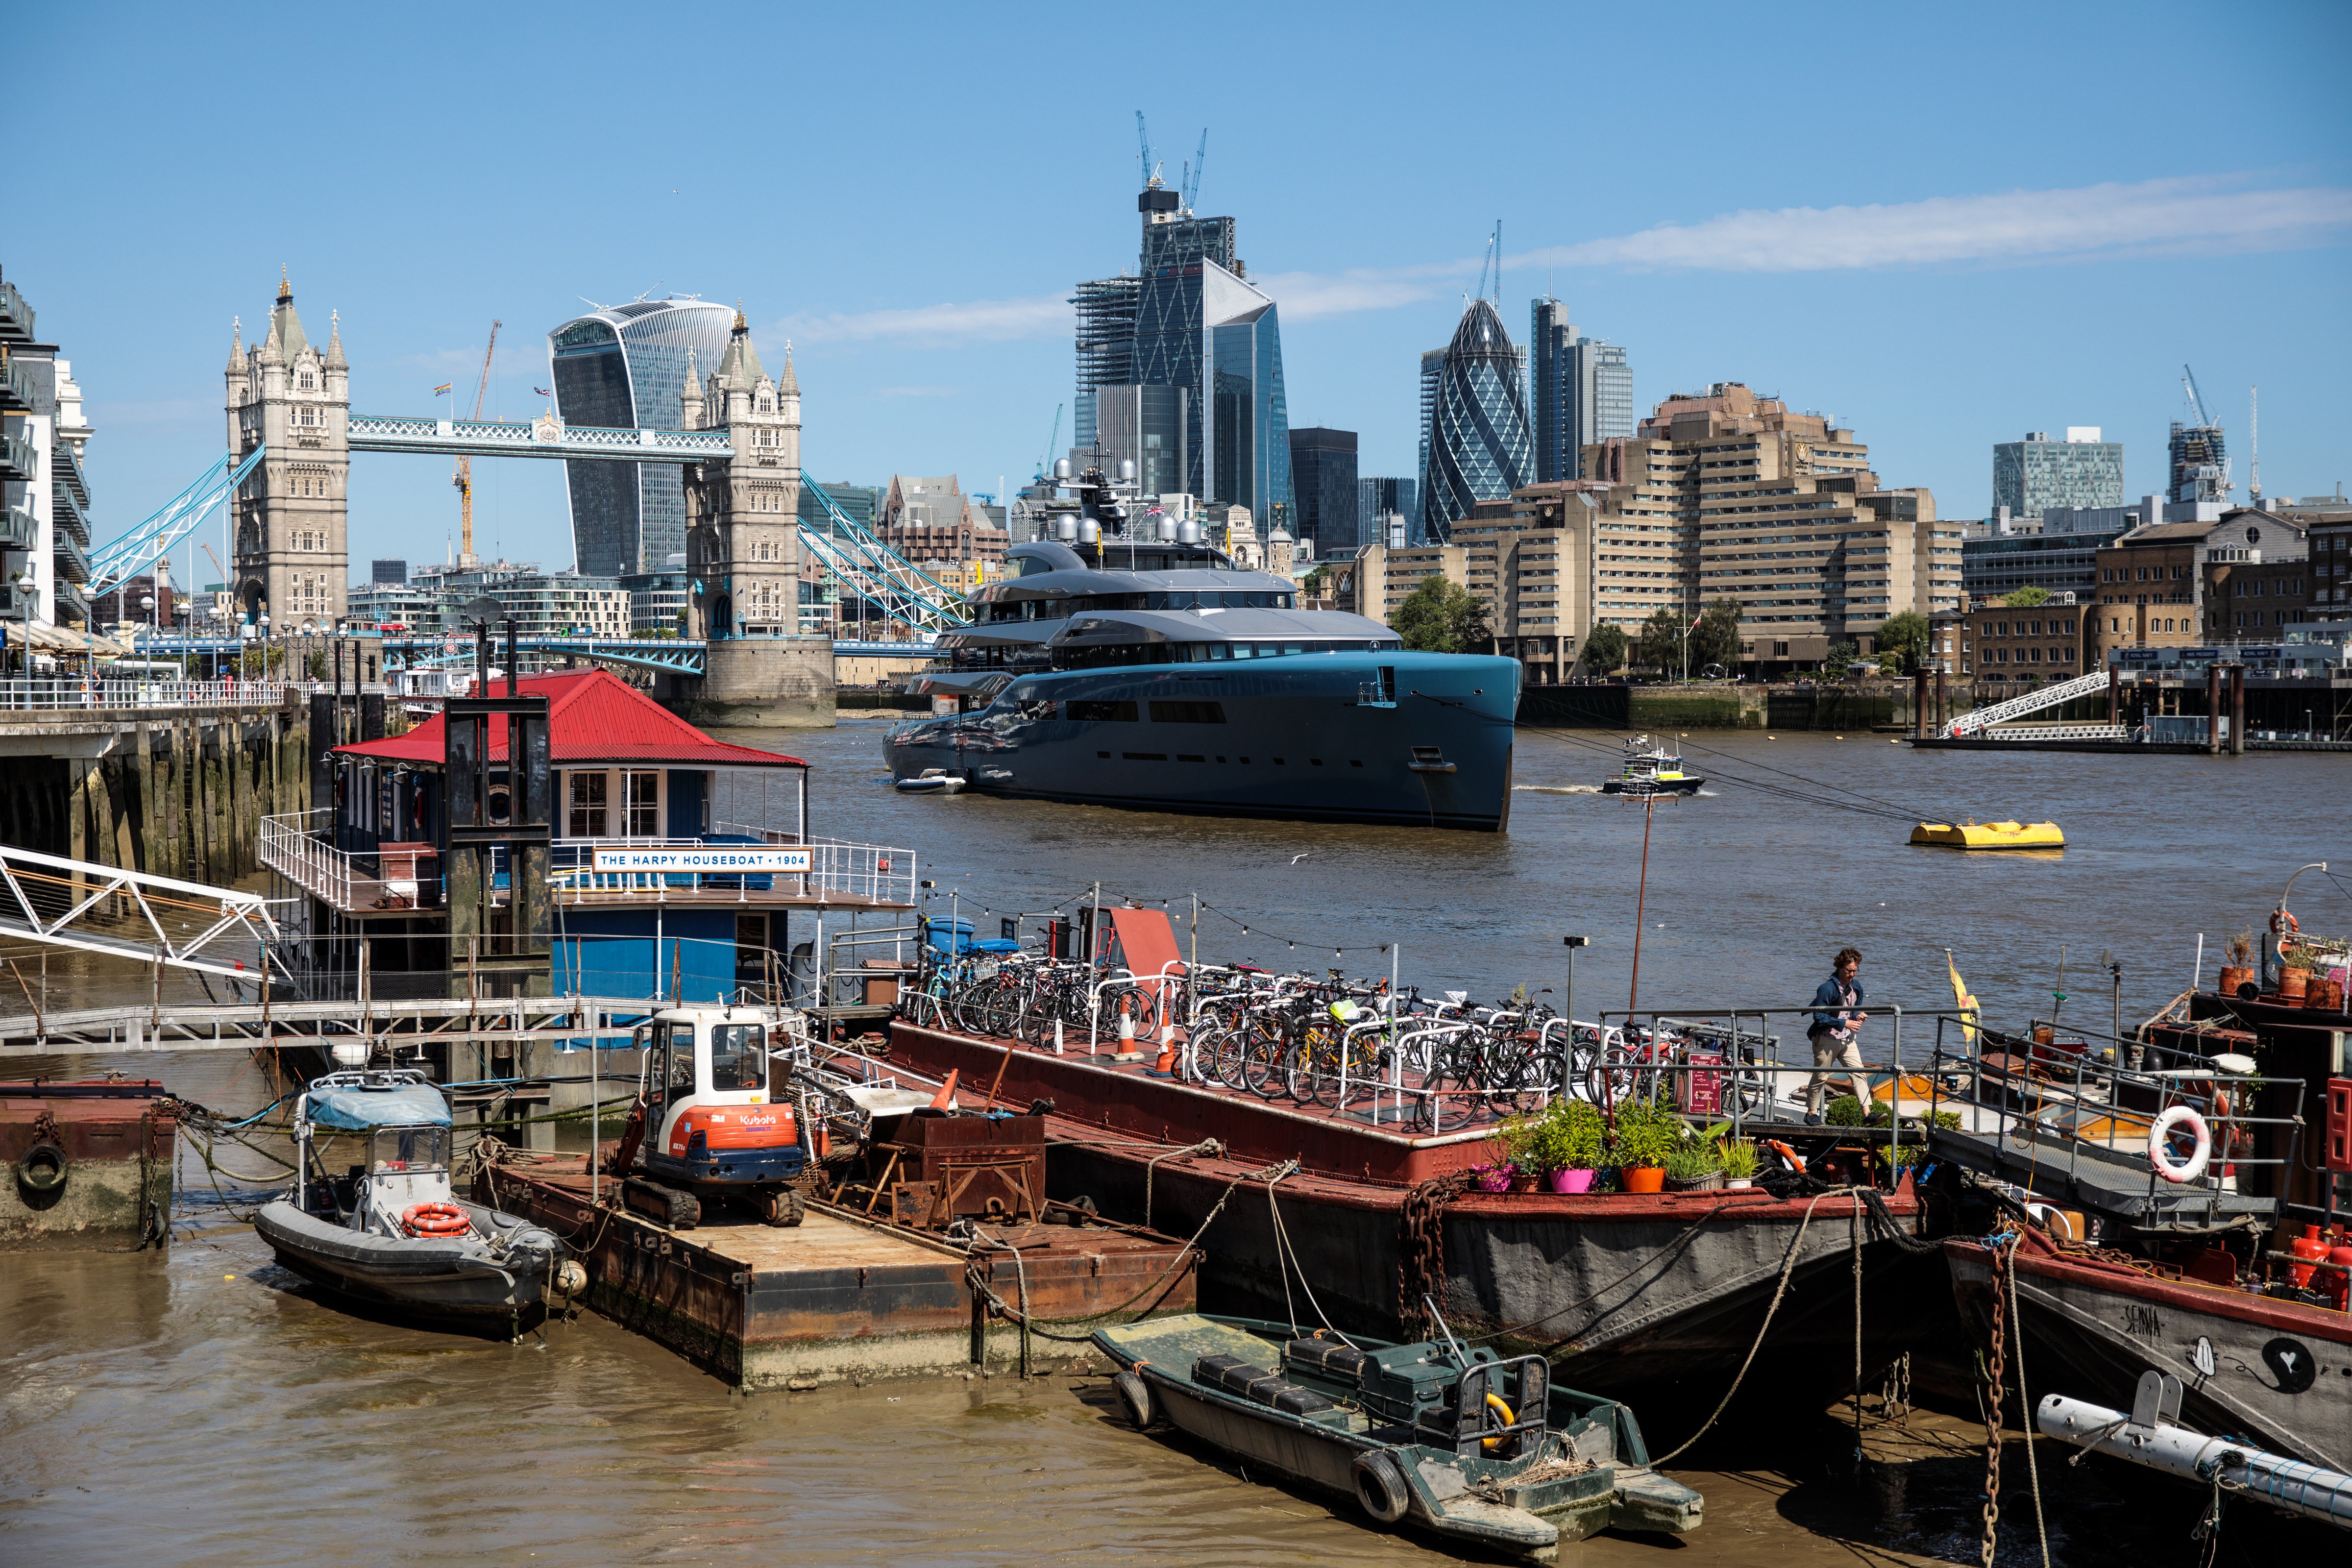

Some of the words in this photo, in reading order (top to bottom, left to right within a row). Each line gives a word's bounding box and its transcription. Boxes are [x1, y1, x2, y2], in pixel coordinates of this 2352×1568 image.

[601, 856, 625, 864] THE
[633, 856, 677, 864] HARPY
[684, 856, 763, 864] HOUSEBOAT
[777, 856, 804, 864] 1904
[740, 1115, 776, 1125] Kubota
